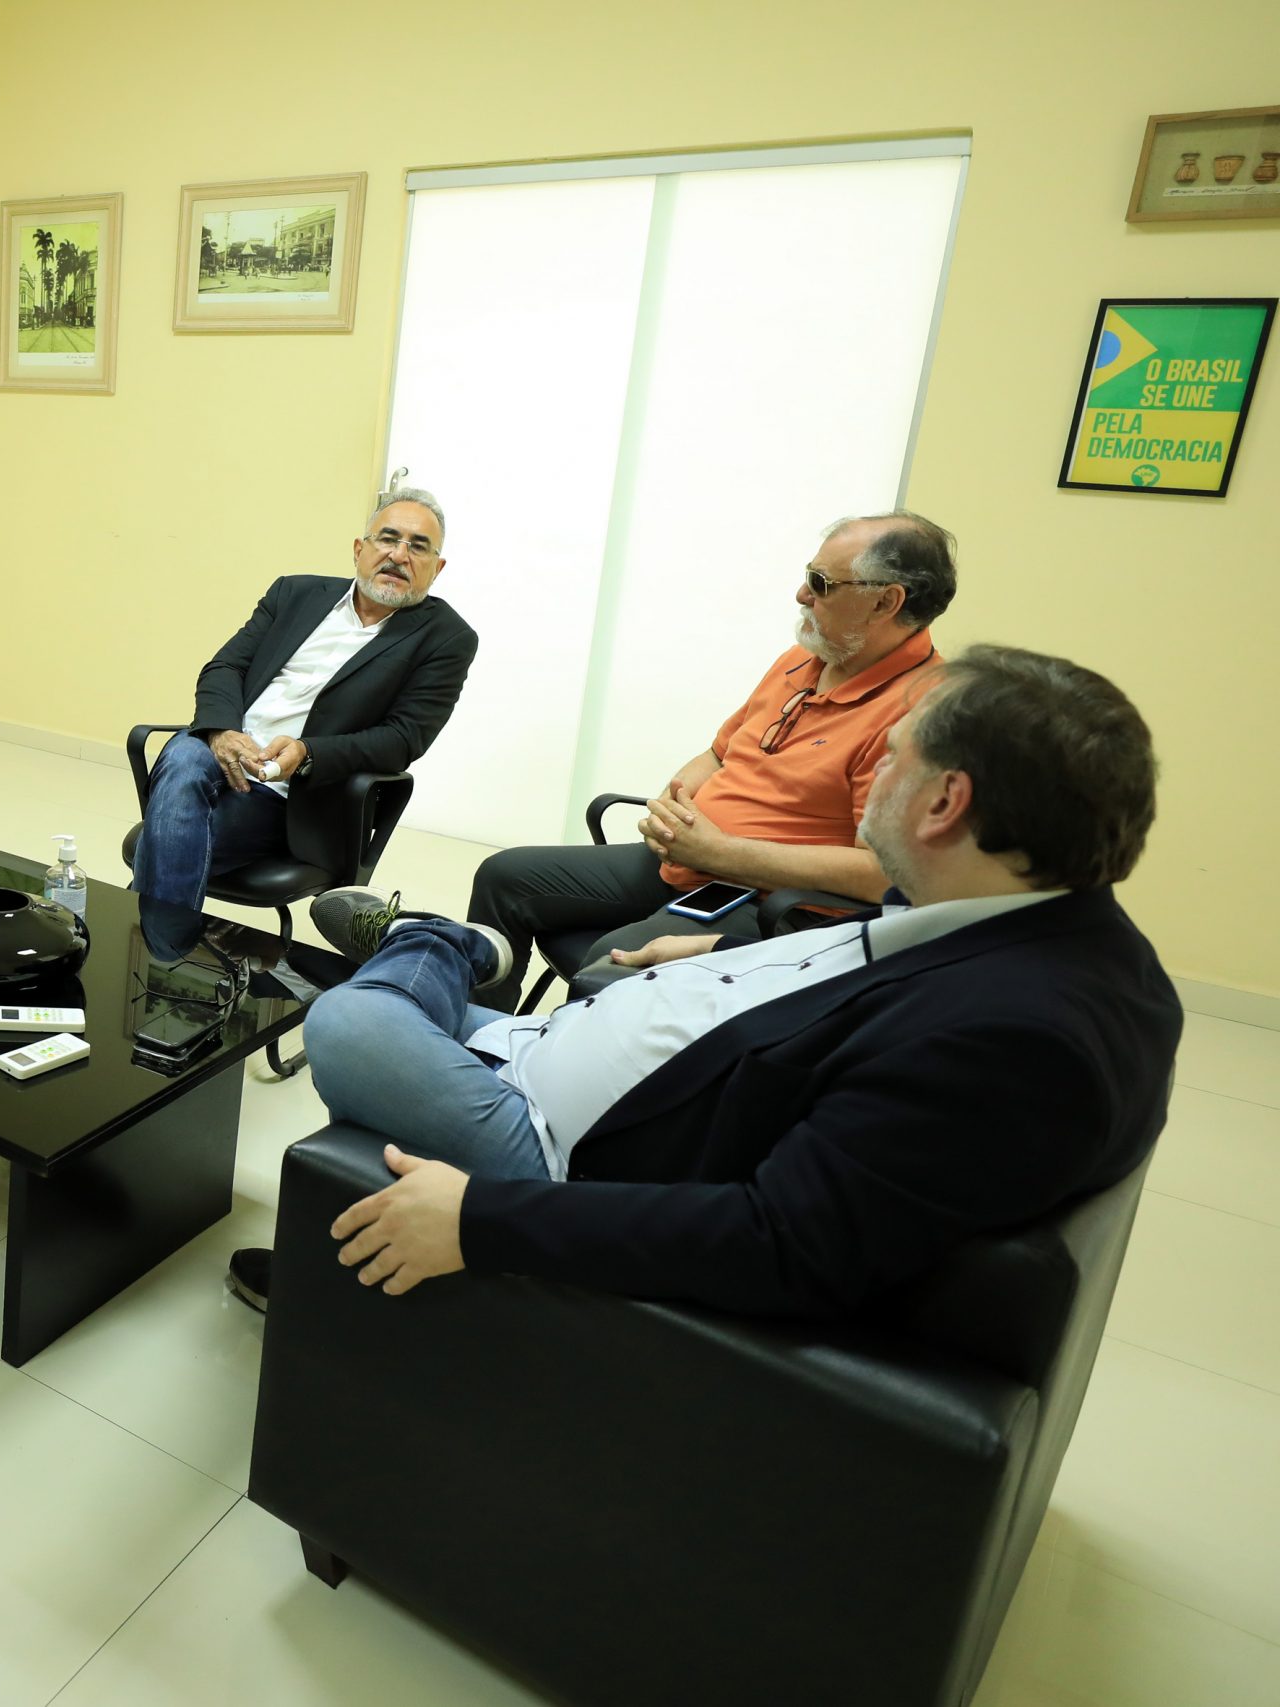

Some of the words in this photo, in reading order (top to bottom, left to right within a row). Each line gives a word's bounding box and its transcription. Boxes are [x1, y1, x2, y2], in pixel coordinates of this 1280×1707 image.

[1145, 358, 1162, 382] O
[1166, 359, 1243, 383] BRASIL
[1139, 384, 1170, 407] SE
[1172, 385, 1218, 408] UNE
[1092, 412, 1143, 435] PELA
[1087, 437, 1223, 463] DEMOCRACIA
